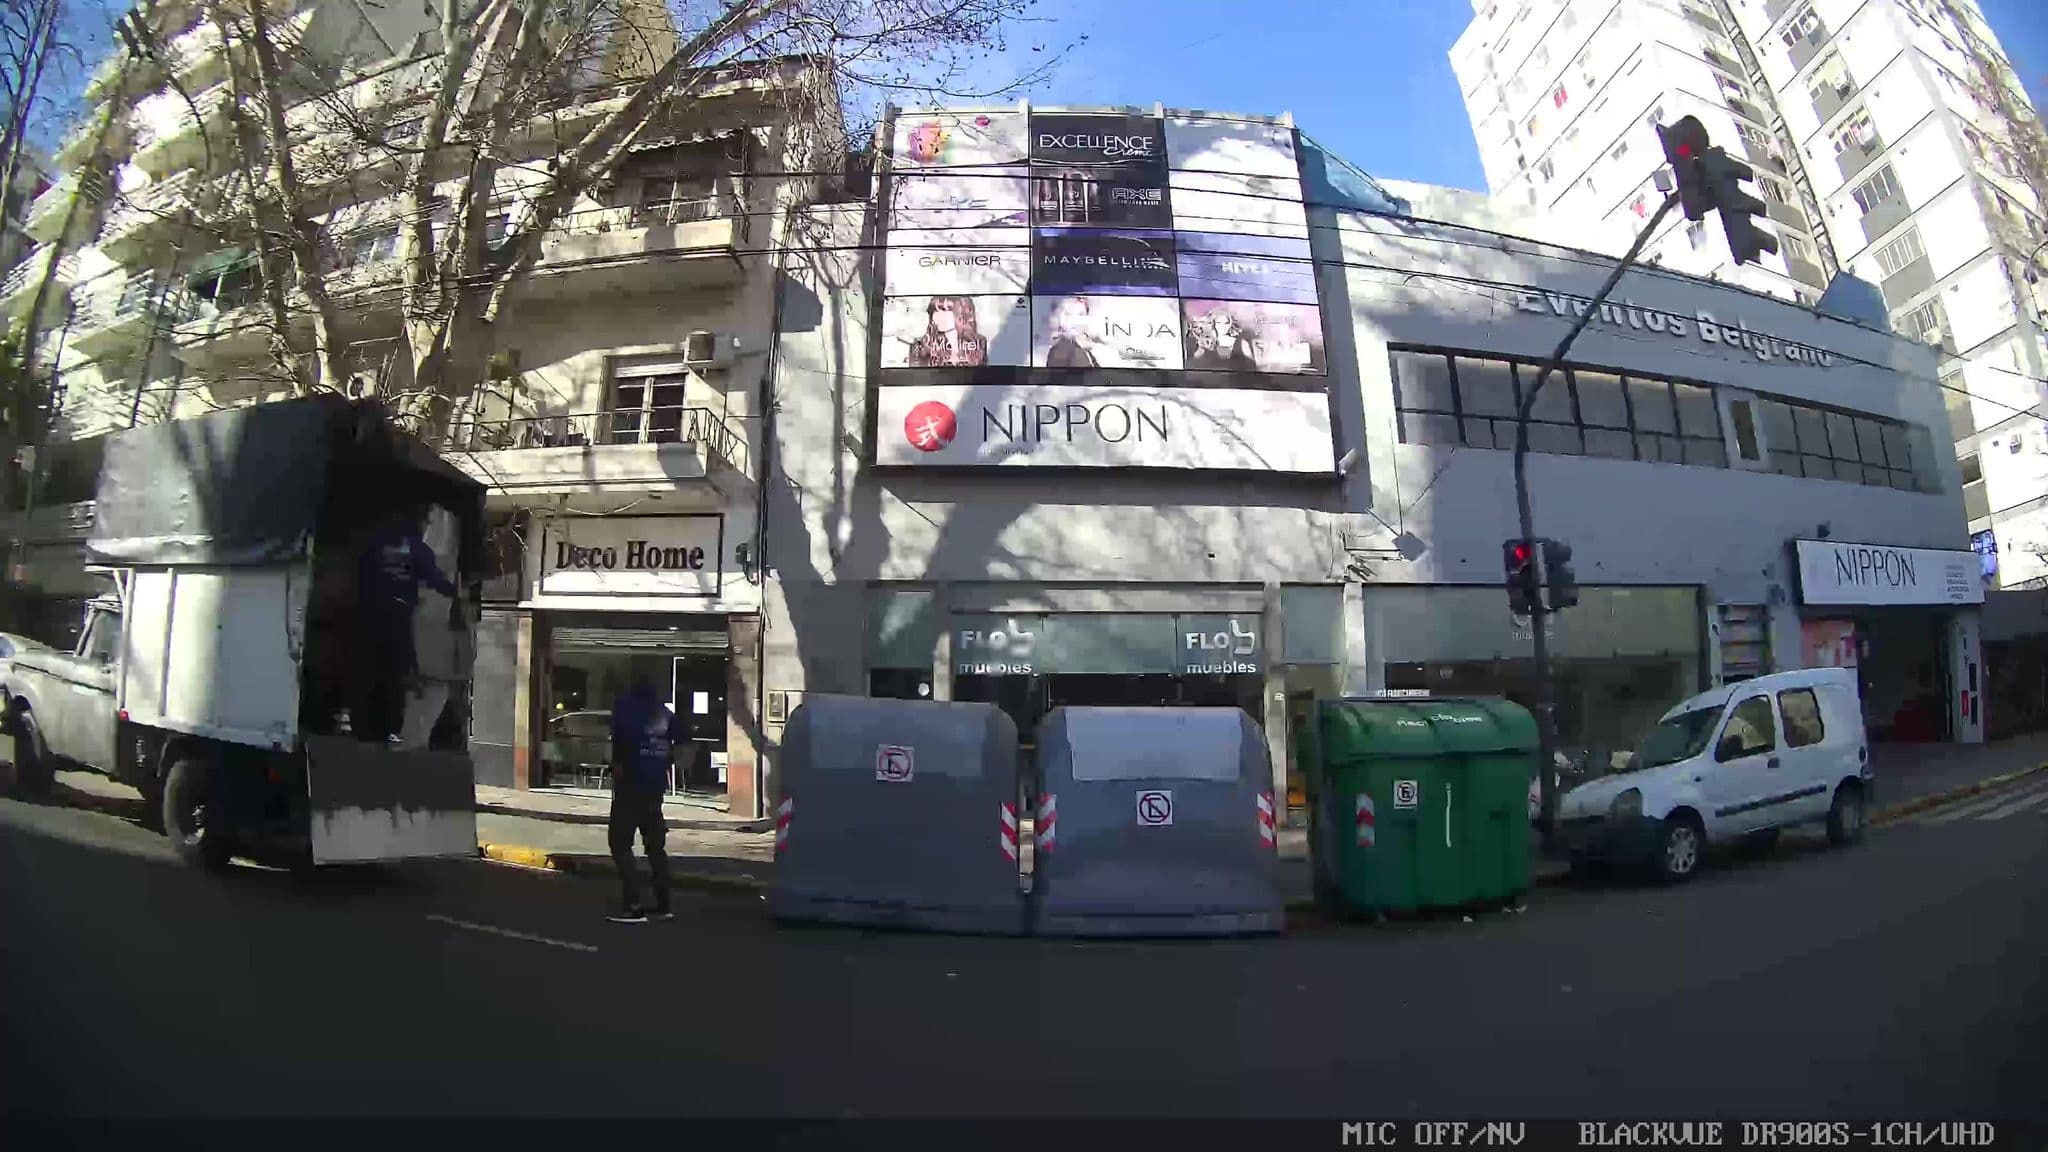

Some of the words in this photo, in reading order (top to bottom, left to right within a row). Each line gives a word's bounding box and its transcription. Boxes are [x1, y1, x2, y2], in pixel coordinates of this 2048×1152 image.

[1039, 134, 1153, 150] EXCELLENCE
[1111, 187, 1162, 201] AXE
[1517, 290, 1687, 337] Eventos
[1696, 306, 1833, 368] Belgrano
[983, 403, 1170, 443] NIPPON
[555, 541, 618, 569] Deco
[625, 540, 705, 569] Home
[1834, 548, 1917, 587] NIPPON
[1185, 660, 1257, 674] muebles
